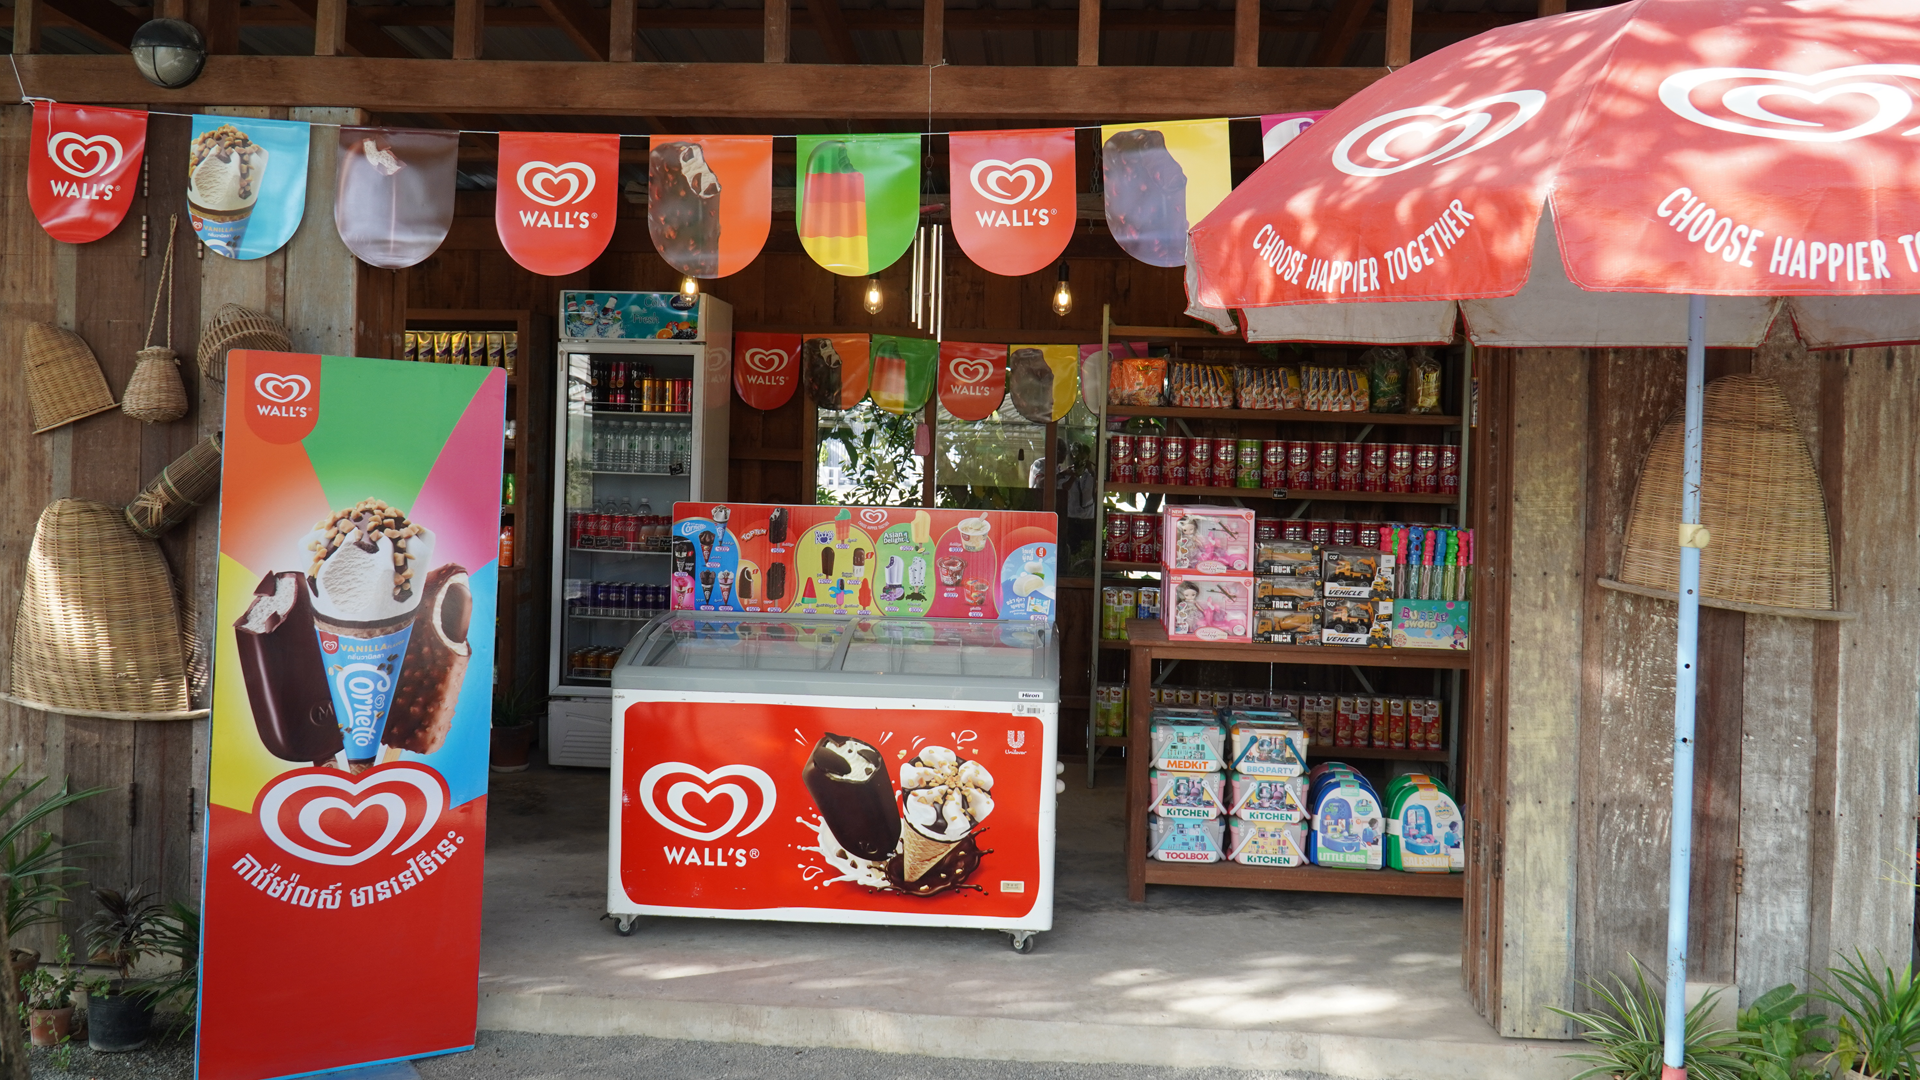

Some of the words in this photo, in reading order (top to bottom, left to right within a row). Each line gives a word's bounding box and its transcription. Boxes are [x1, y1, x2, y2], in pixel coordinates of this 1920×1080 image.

[1656, 187, 1764, 268] CHOOSE
[1769, 235, 1891, 282] HAPPIER
[1252, 223, 1308, 285] CHOOSE
[1305, 257, 1381, 294] HAPPIER
[1383, 198, 1475, 284] TOGETHER
[632, 312, 660, 324] Fresh
[1270, 565, 1291, 573] TRUCK
[1272, 600, 1293, 609] TRUCK
[1401, 606, 1448, 622] BUBBLE
[1404, 620, 1437, 629] SWORD
[1271, 634, 1292, 642] TRUCK
[340, 643, 387, 652] VANILLA
[336, 662, 391, 747] Cornetto
[1246, 765, 1265, 774] BBQ
[1265, 766, 1295, 775] PARTY
[1165, 852, 1209, 861] TOOLBOX
[1319, 852, 1344, 861] LITTLE
[1345, 853, 1366, 863] DOGS
[1403, 856, 1449, 867] SALESMAN
